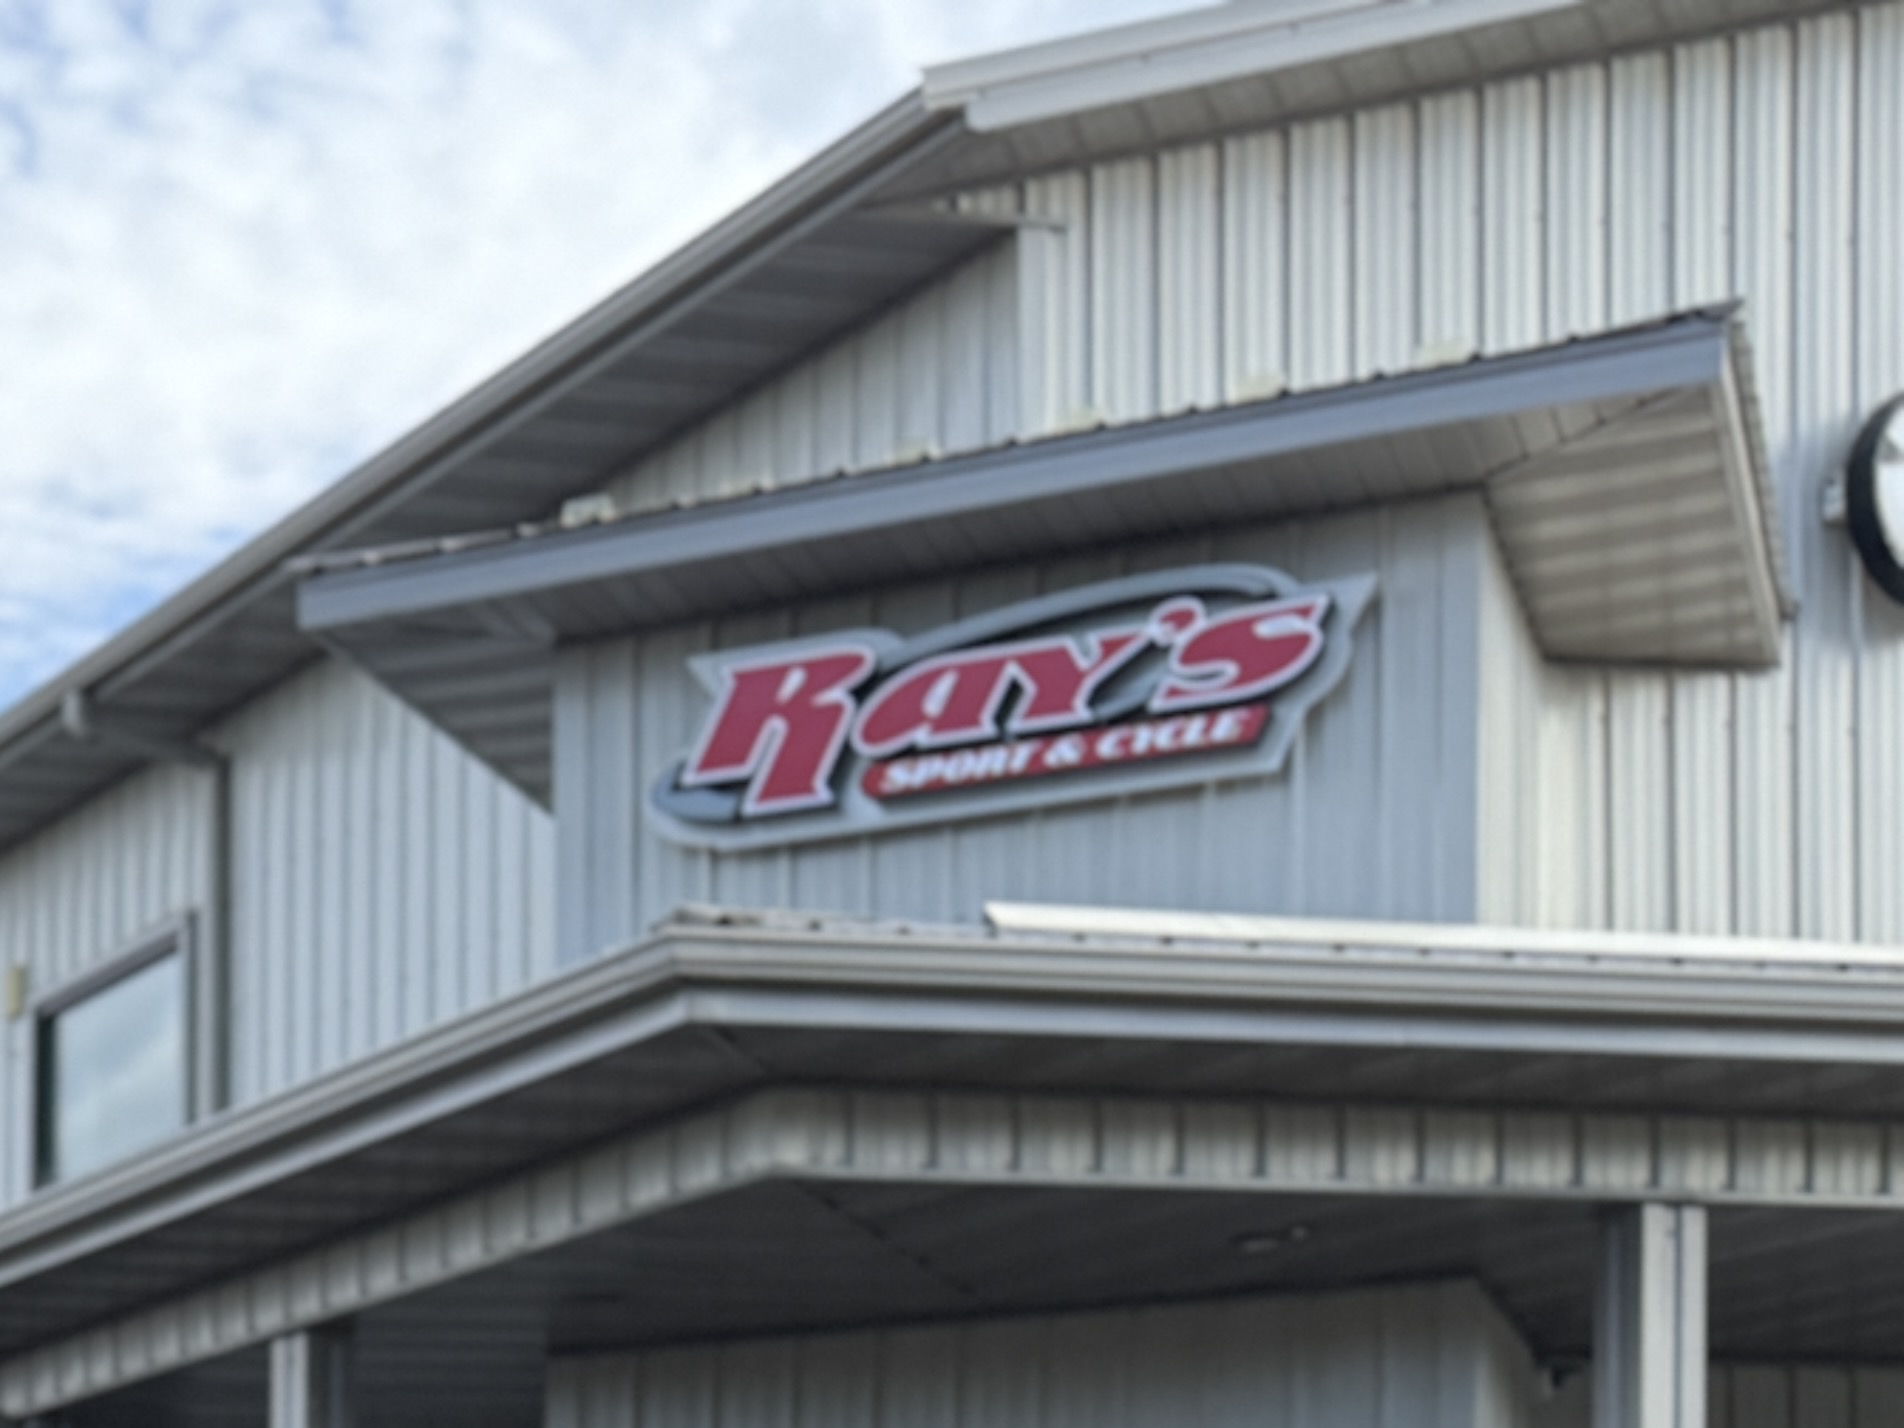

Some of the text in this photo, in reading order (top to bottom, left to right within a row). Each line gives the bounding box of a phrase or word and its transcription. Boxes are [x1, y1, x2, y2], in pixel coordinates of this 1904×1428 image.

[879, 712, 1252, 794] SPORT & CYCLE
